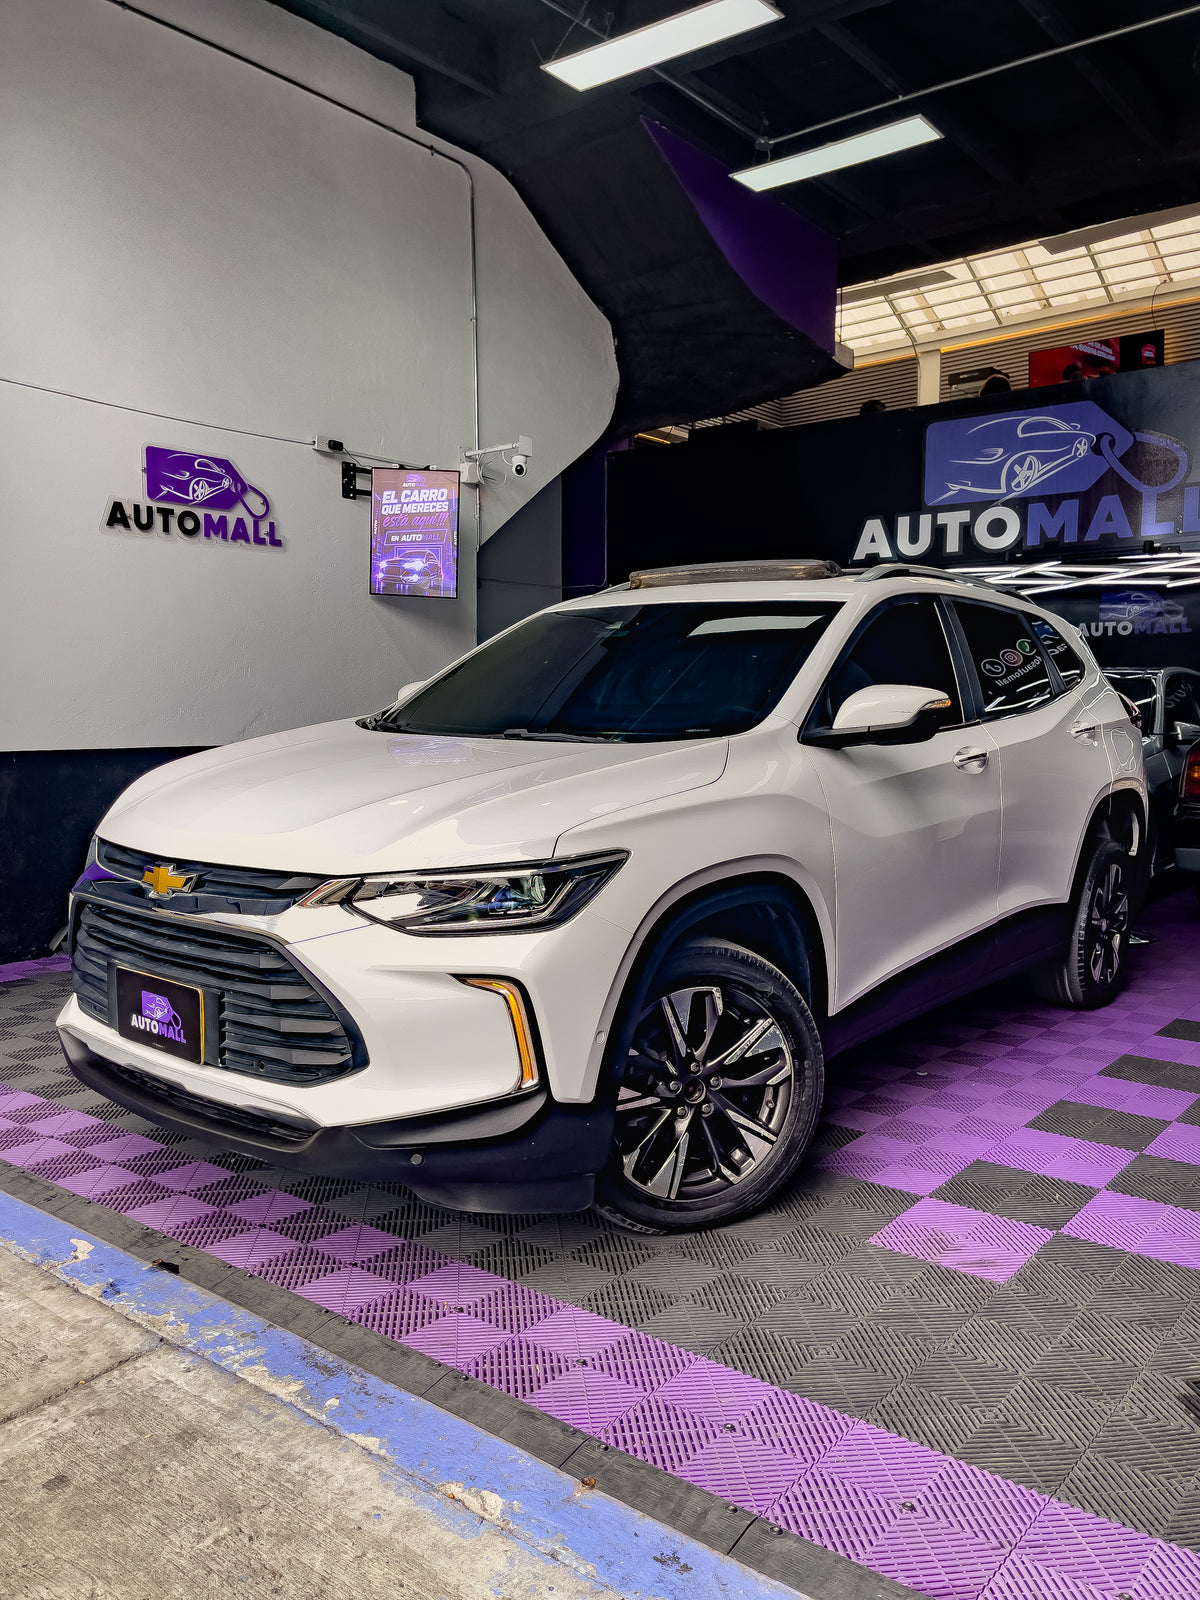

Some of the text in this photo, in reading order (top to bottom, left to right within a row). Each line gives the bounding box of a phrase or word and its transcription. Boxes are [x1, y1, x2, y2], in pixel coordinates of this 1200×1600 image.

[382, 488, 448, 504] EL CARRO
[381, 502, 449, 515] QUE MERECES
[105, 500, 283, 547] AUTOMALL
[382, 513, 409, 527] está
[852, 486, 1200, 561] AUTOMALL
[400, 534, 441, 542] AUTOMALL
[1078, 617, 1193, 637] AUTOMALL
[131, 1013, 187, 1044] AUTOMALL
